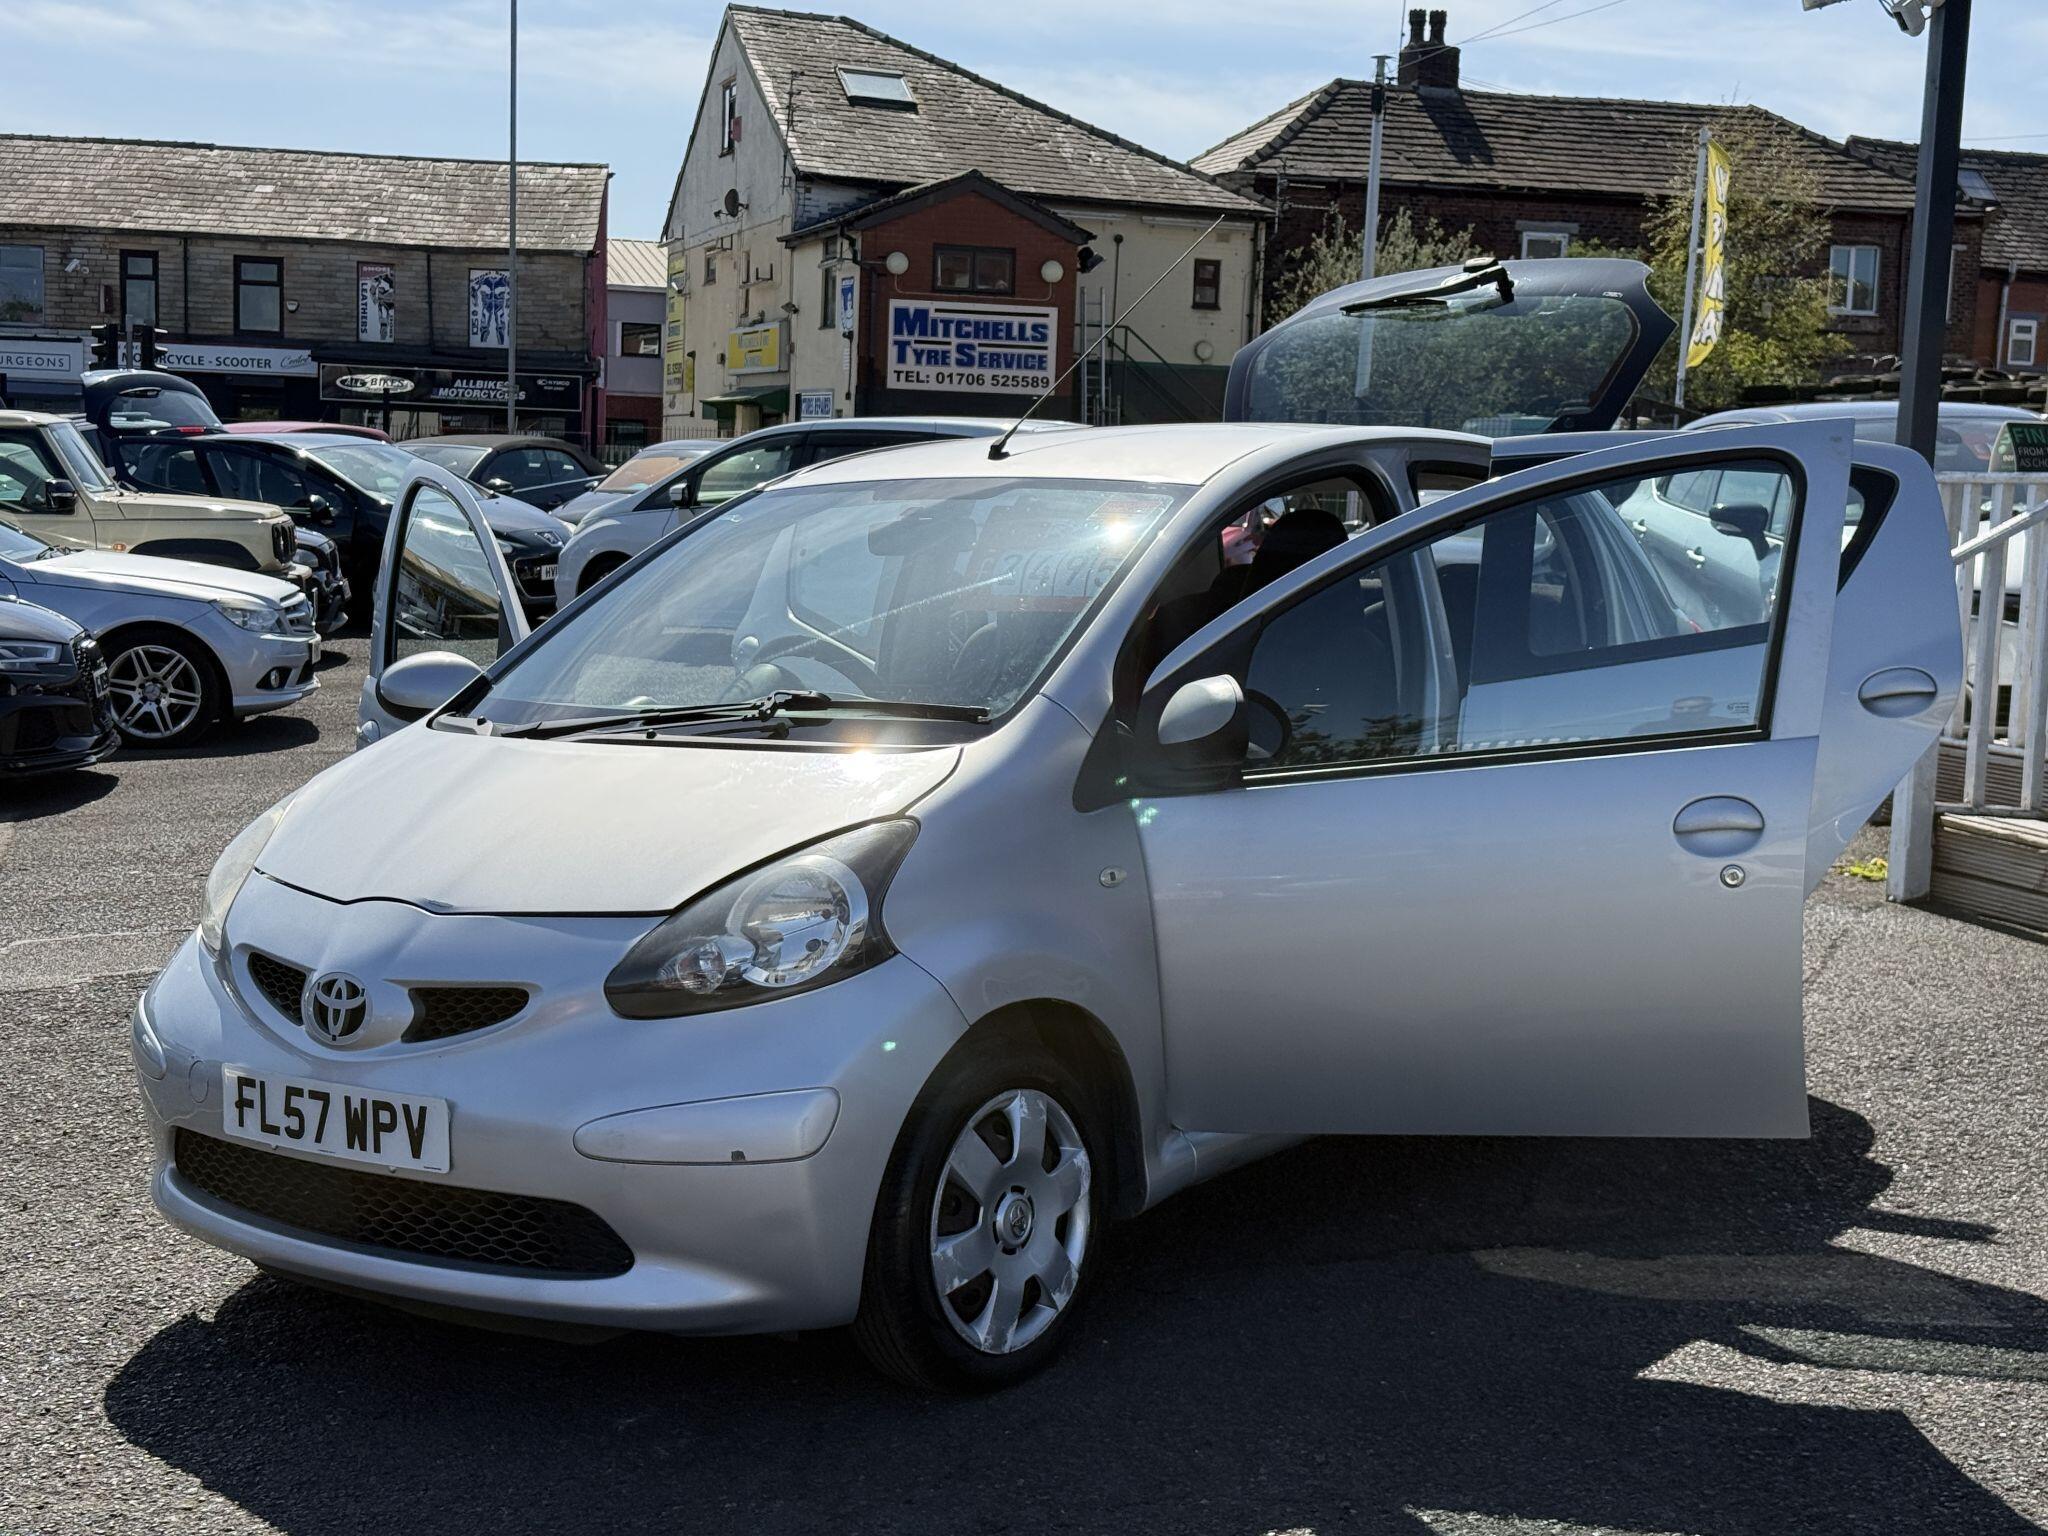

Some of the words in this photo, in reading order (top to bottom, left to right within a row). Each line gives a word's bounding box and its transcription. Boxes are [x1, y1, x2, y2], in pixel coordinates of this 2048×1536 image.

[893, 306, 1049, 343] MITCHELLS
[215, 356, 272, 369] SCOOTER
[893, 340, 952, 366] TYRE
[955, 342, 1048, 370] SERVICE
[893, 370, 930, 384] TEL:
[935, 371, 985, 386] 01706
[991, 374, 1049, 388] 525589
[2018, 447, 2044, 456] FROM
[235, 1075, 331, 1144] FL57
[344, 1095, 428, 1160] WPV
